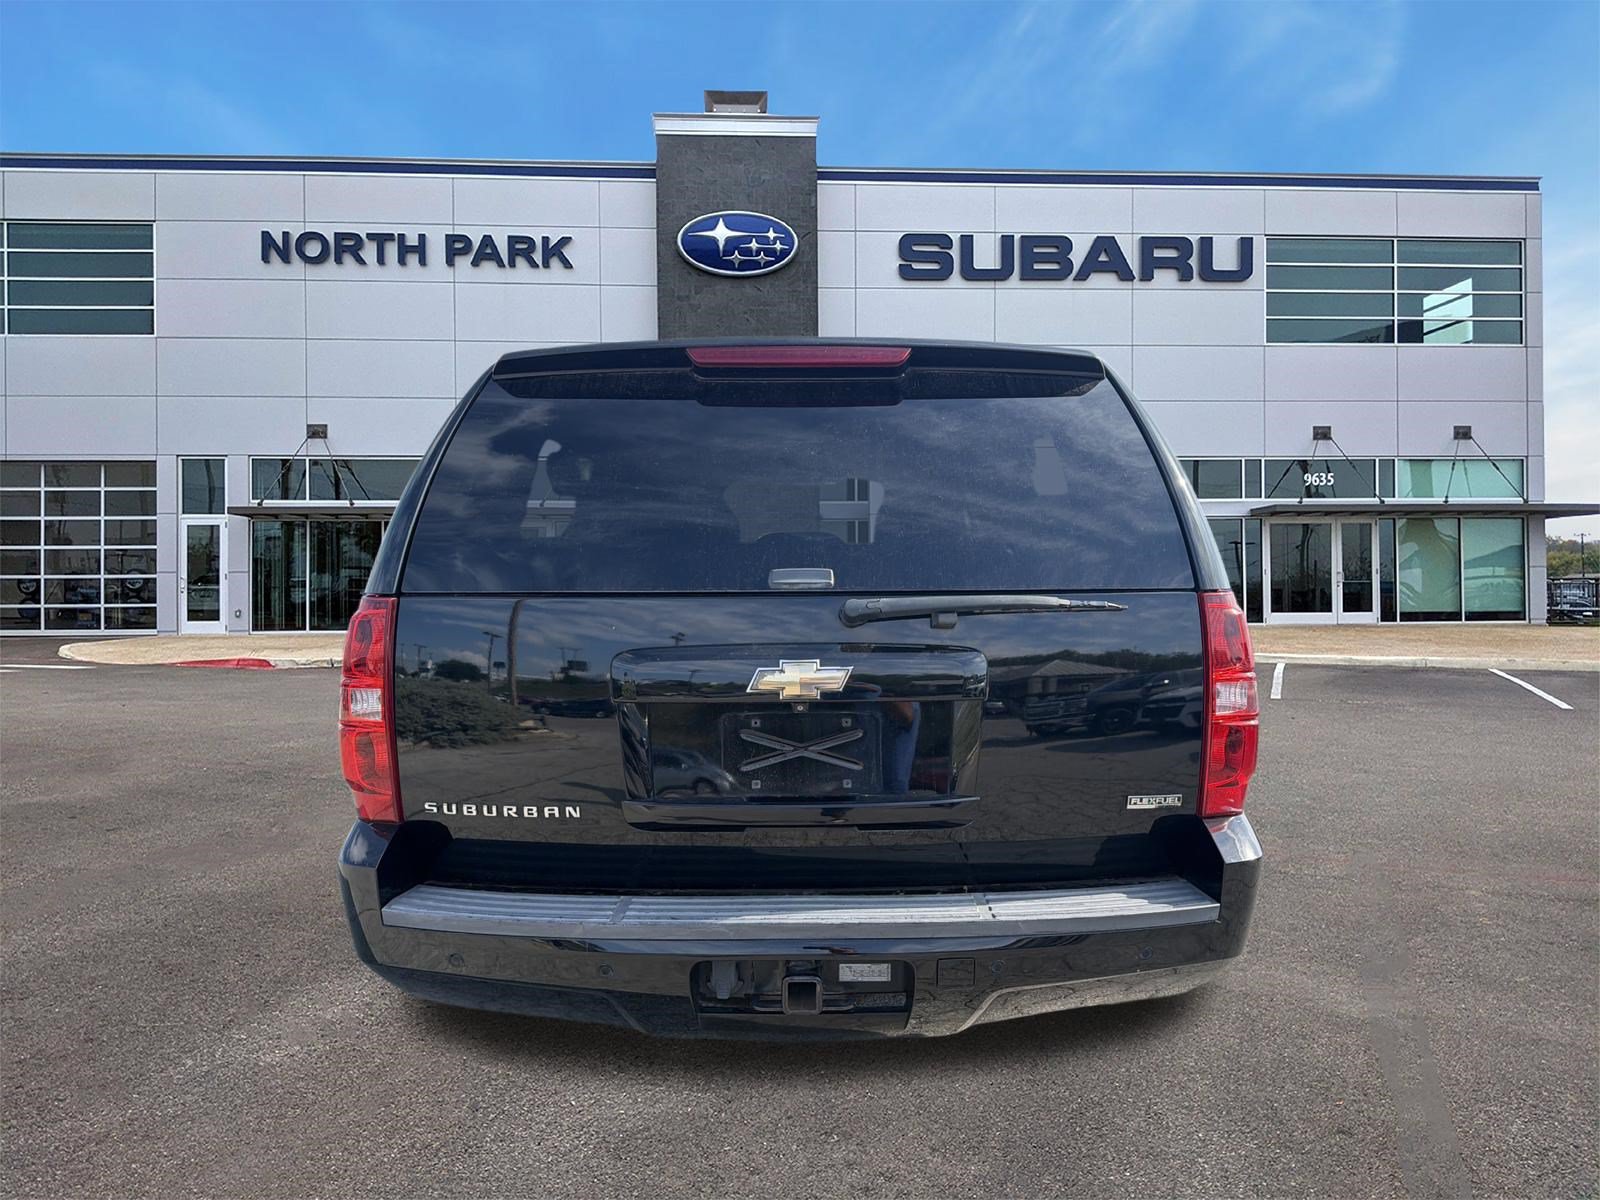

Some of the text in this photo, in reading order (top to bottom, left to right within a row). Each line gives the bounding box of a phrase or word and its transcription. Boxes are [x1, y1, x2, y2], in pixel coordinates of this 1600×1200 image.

[261, 229, 573, 270] NORTH PARK
[898, 232, 1254, 283] SUBARU
[1303, 472, 1335, 487] 9635
[424, 801, 581, 819] SUBURBAN
[1130, 796, 1181, 806] FLEXFUEL
